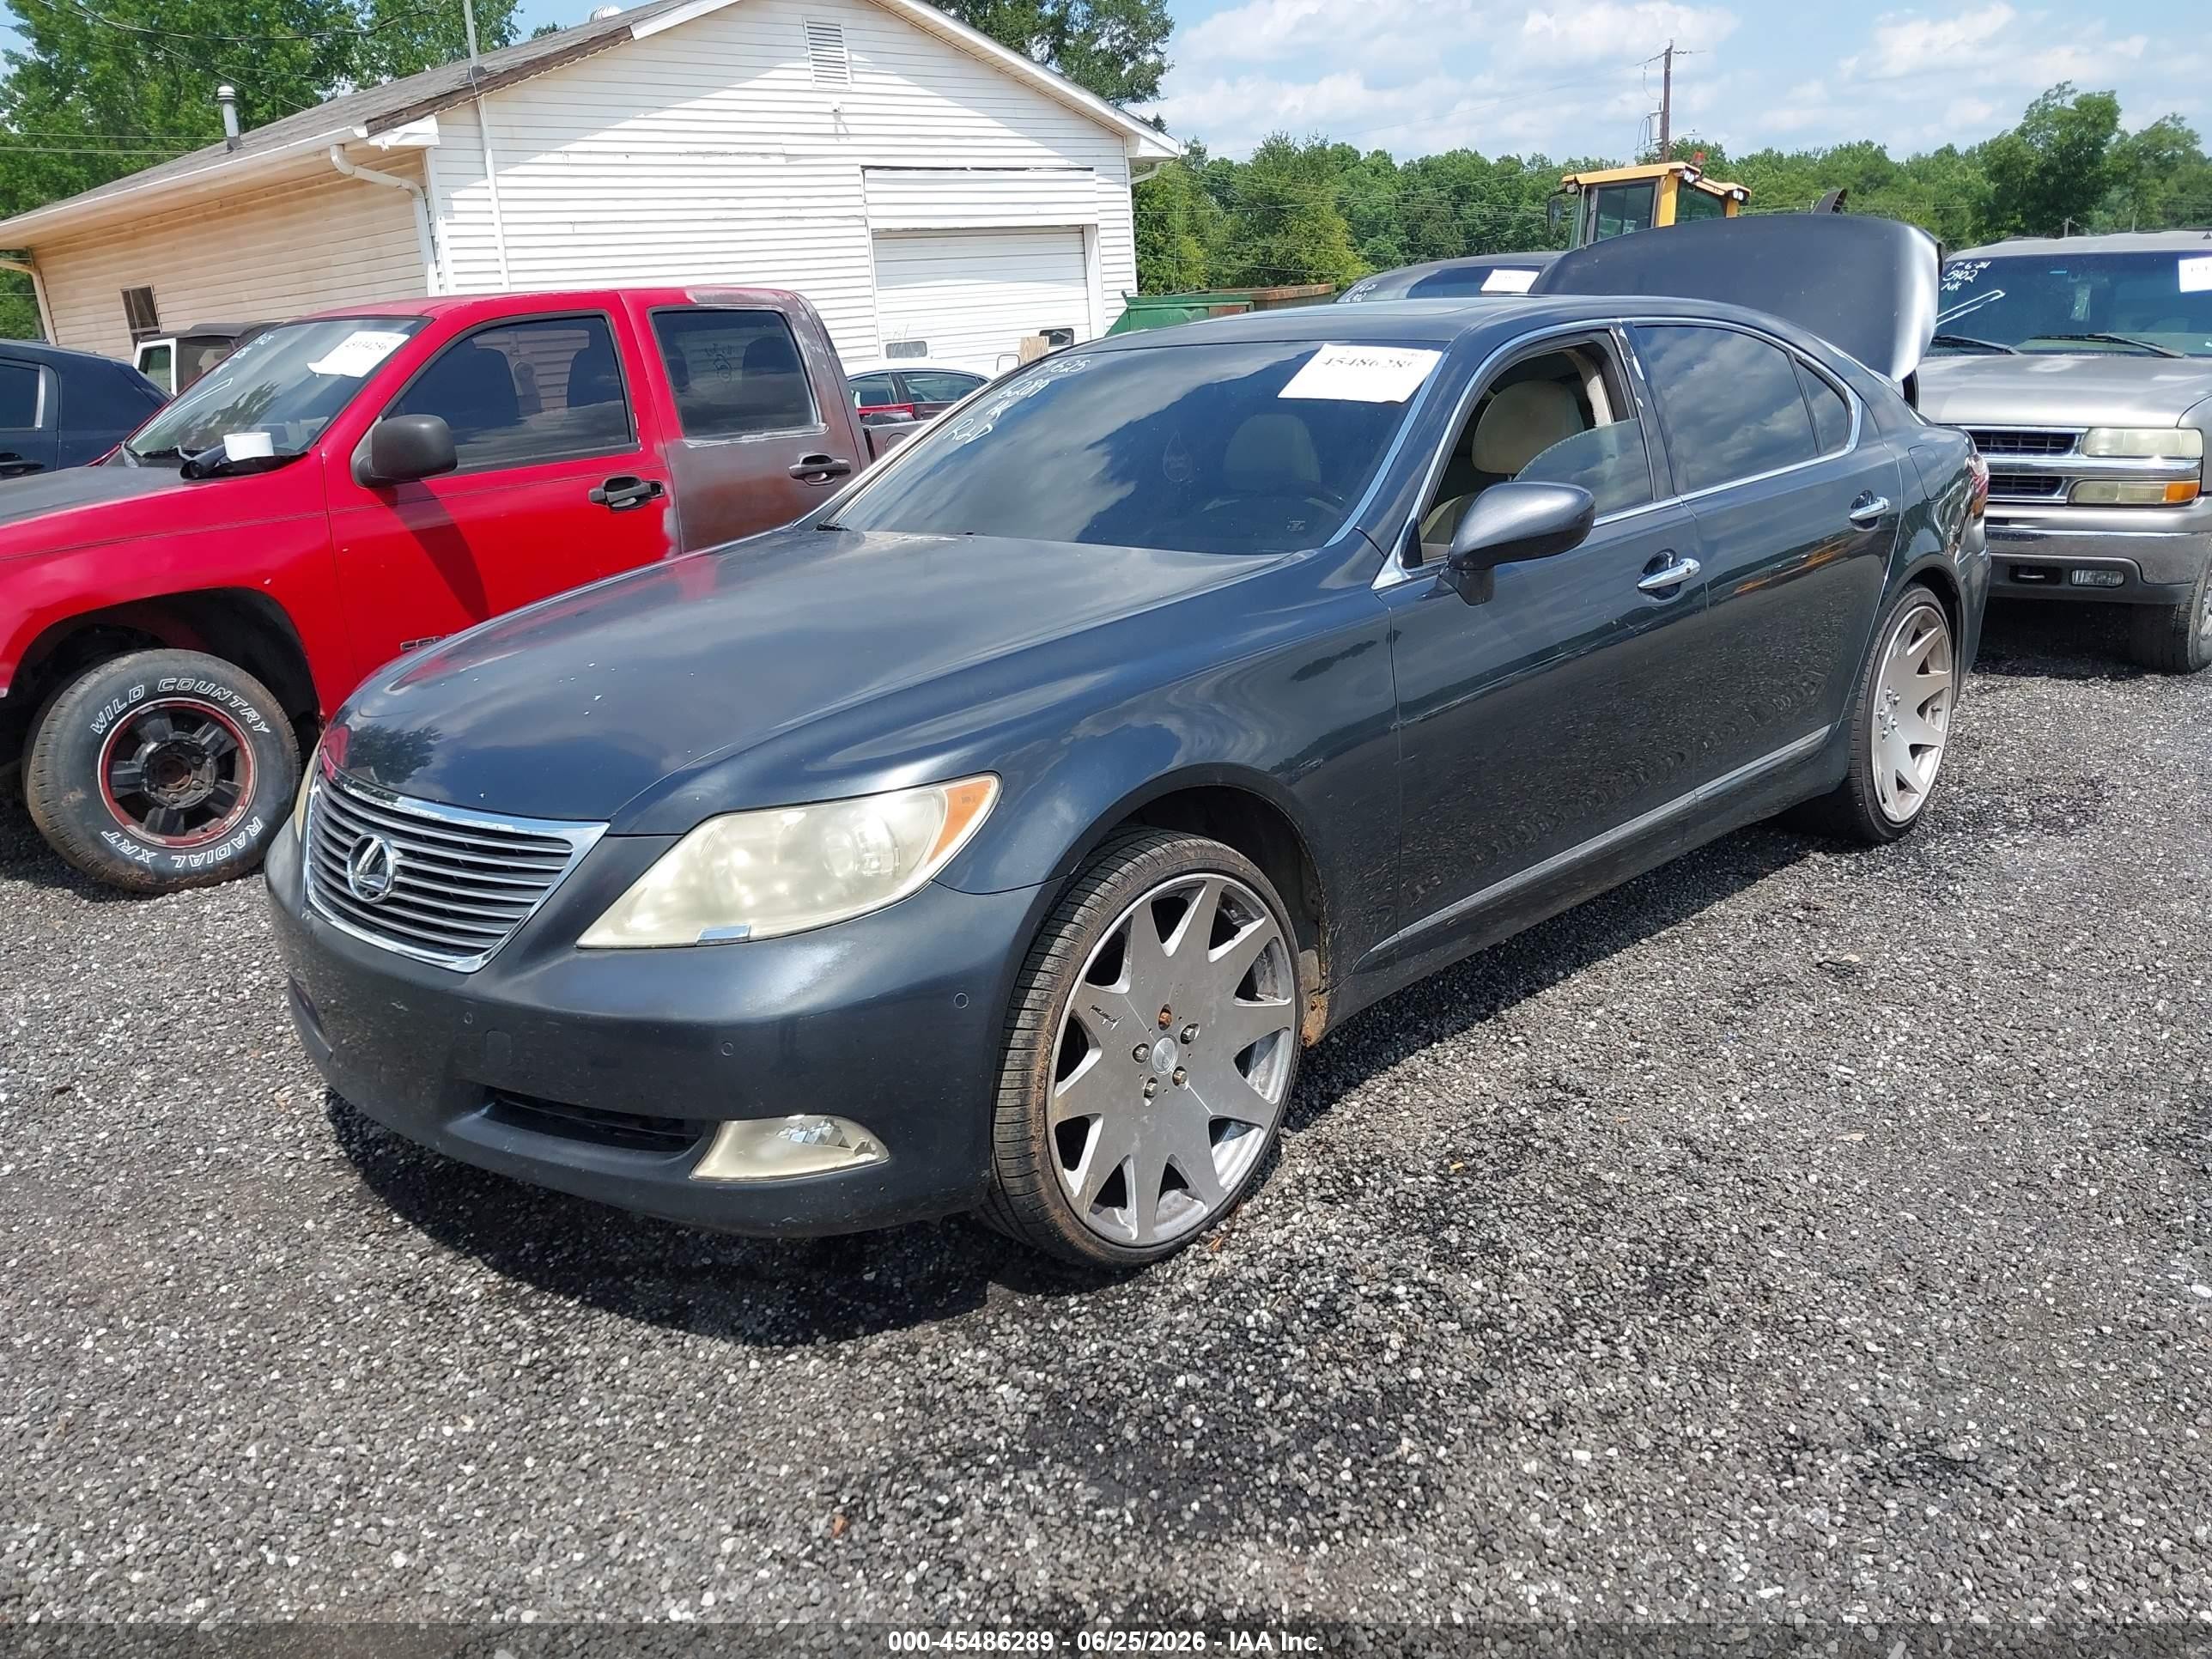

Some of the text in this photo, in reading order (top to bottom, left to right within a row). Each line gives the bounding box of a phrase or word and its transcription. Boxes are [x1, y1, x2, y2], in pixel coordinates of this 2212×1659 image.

[89, 678, 270, 735] WILD COUNTRY
[100, 816, 264, 869] RADIAL XRT
